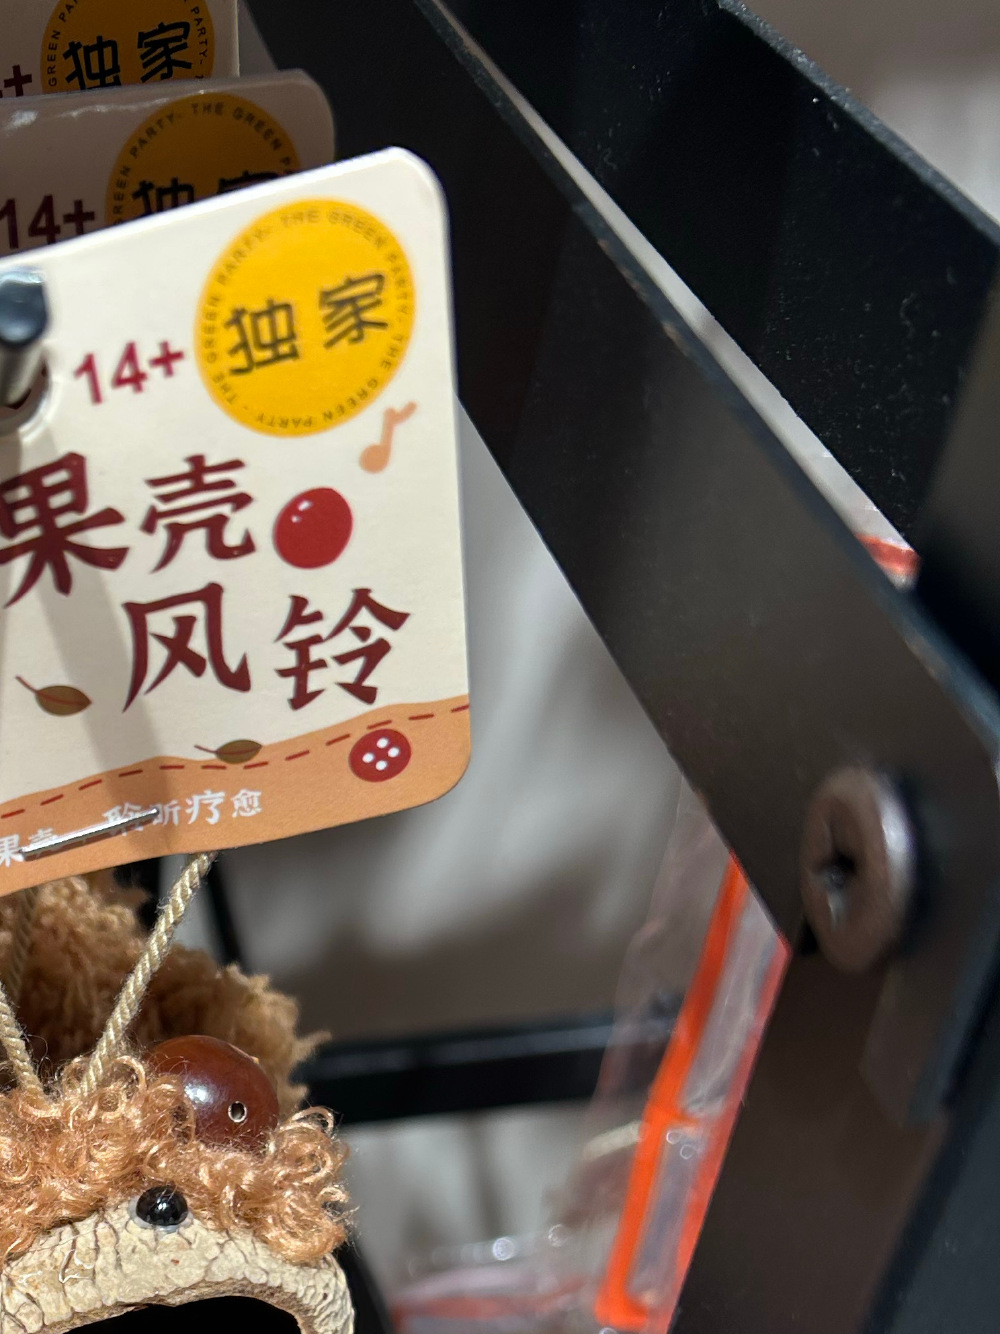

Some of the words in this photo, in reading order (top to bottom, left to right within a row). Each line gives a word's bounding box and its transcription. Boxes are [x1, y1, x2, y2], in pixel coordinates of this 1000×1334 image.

[47, 30, 62, 87] GREEN
[62, 21, 193, 91] 独家
[223, 272, 389, 376] 独家
[74, 340, 185, 406] 14+
[122, 582, 411, 713] 风铃
